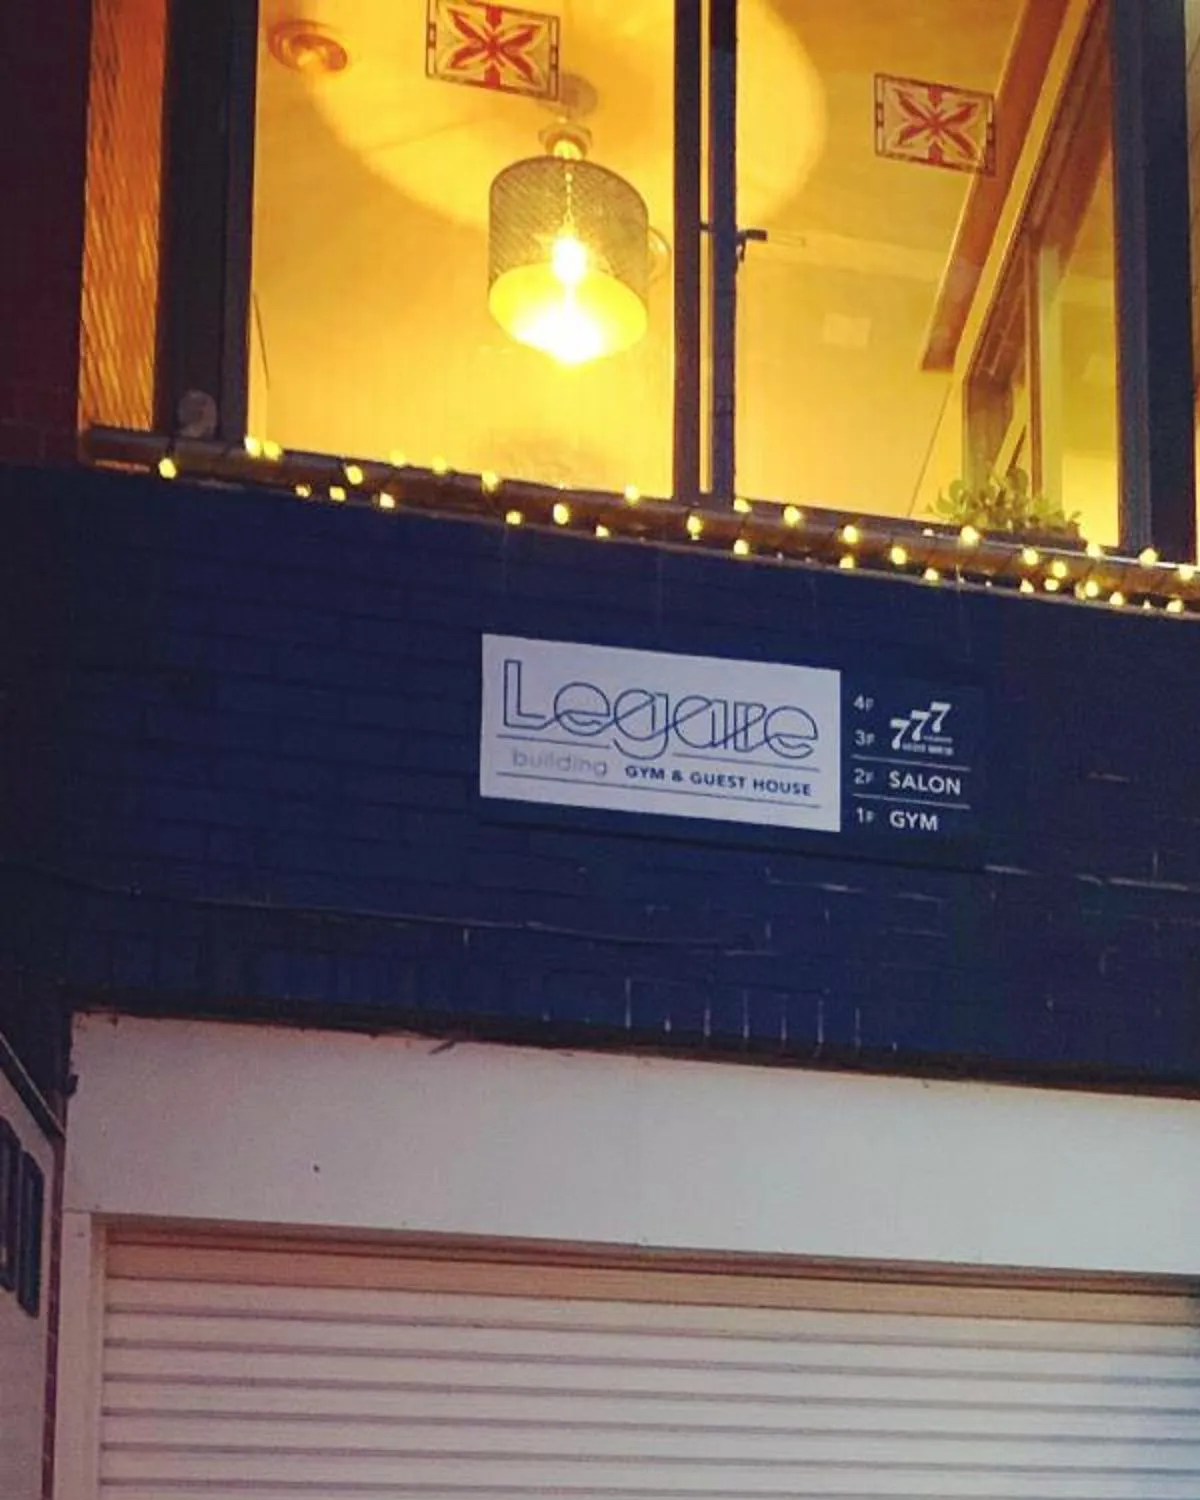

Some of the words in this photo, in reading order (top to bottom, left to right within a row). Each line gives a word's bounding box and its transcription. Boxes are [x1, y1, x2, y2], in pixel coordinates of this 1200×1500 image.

[503, 659, 818, 760] Legare
[890, 701, 951, 750] 777
[511, 749, 608, 777] building
[624, 764, 665, 781] GYM
[672, 769, 683, 782] &
[690, 770, 747, 790] GUEST
[753, 777, 811, 796] HOUSE
[889, 770, 961, 796] SALON
[890, 810, 938, 832] GYM
